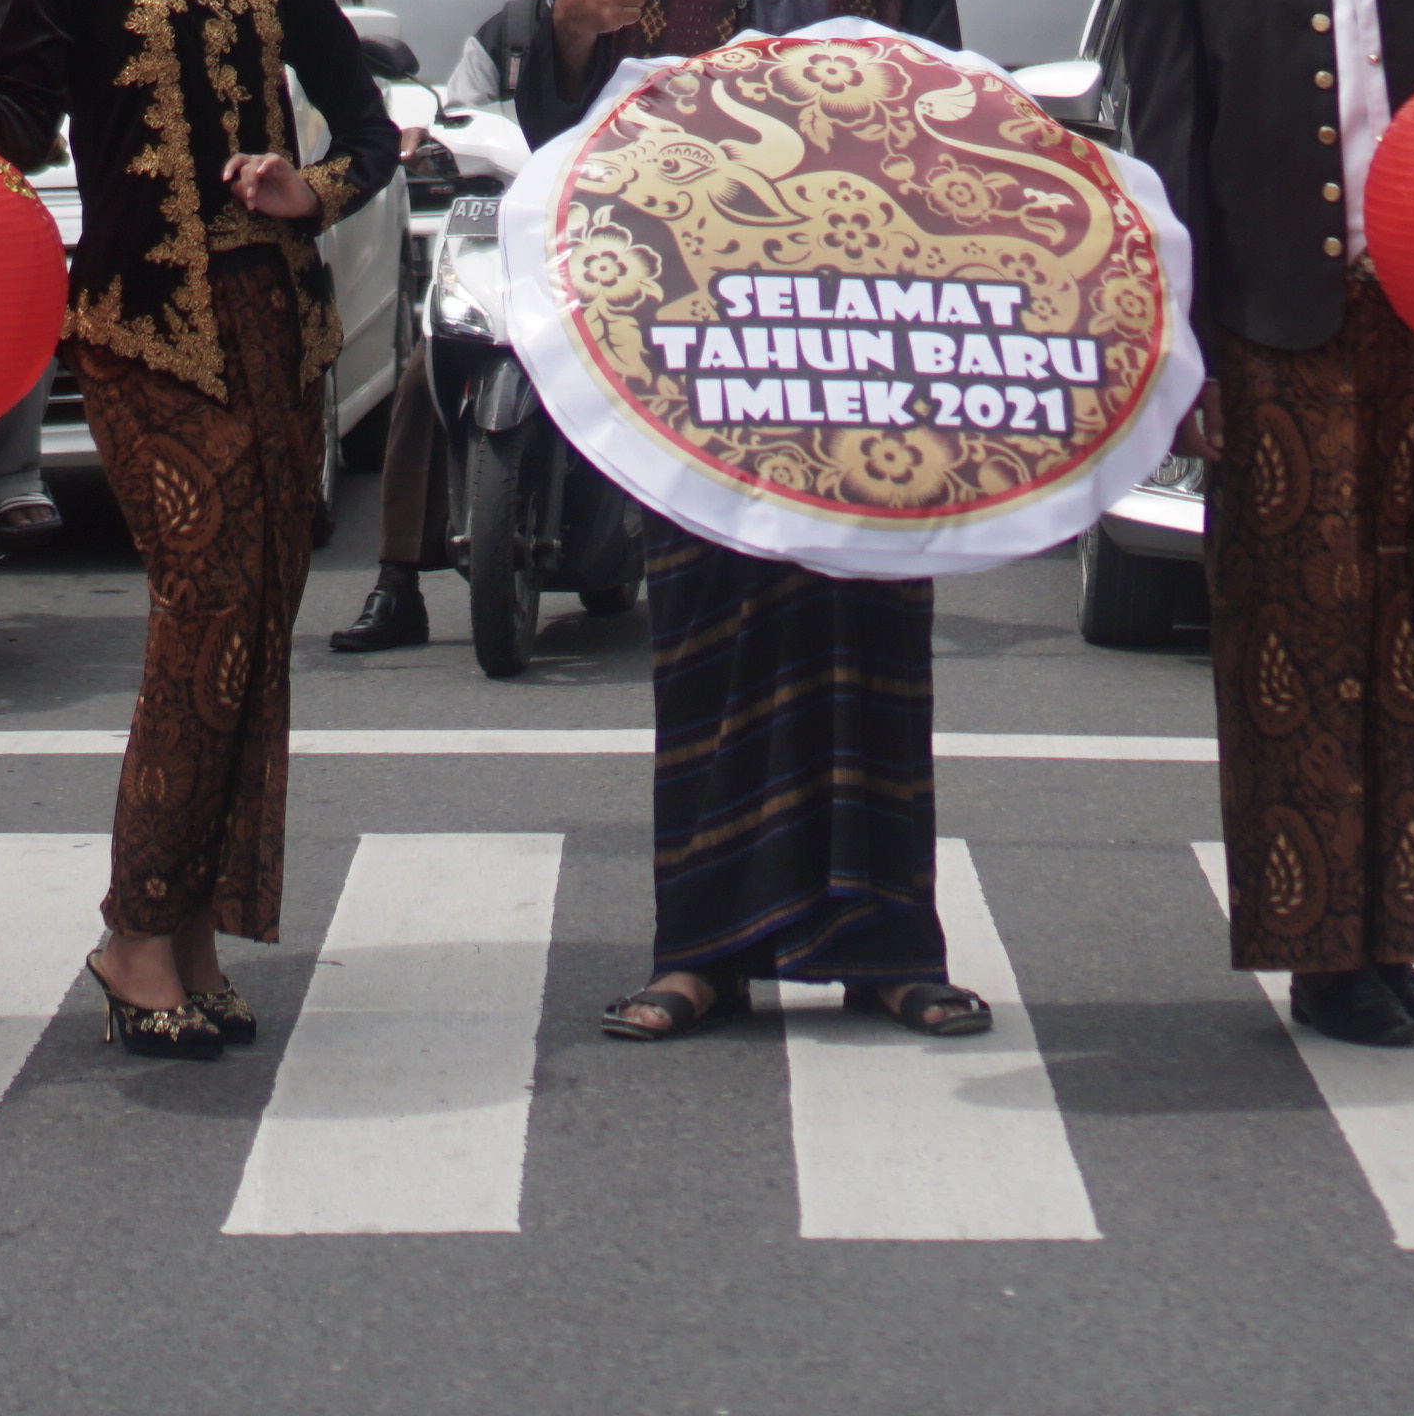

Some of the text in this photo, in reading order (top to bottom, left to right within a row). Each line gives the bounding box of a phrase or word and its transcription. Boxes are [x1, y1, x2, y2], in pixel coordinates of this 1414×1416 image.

[717, 274, 1023, 326] SELAMAT
[650, 326, 1100, 383] TAHUN BARU
[694, 378, 1068, 433] IMLEK 2021
